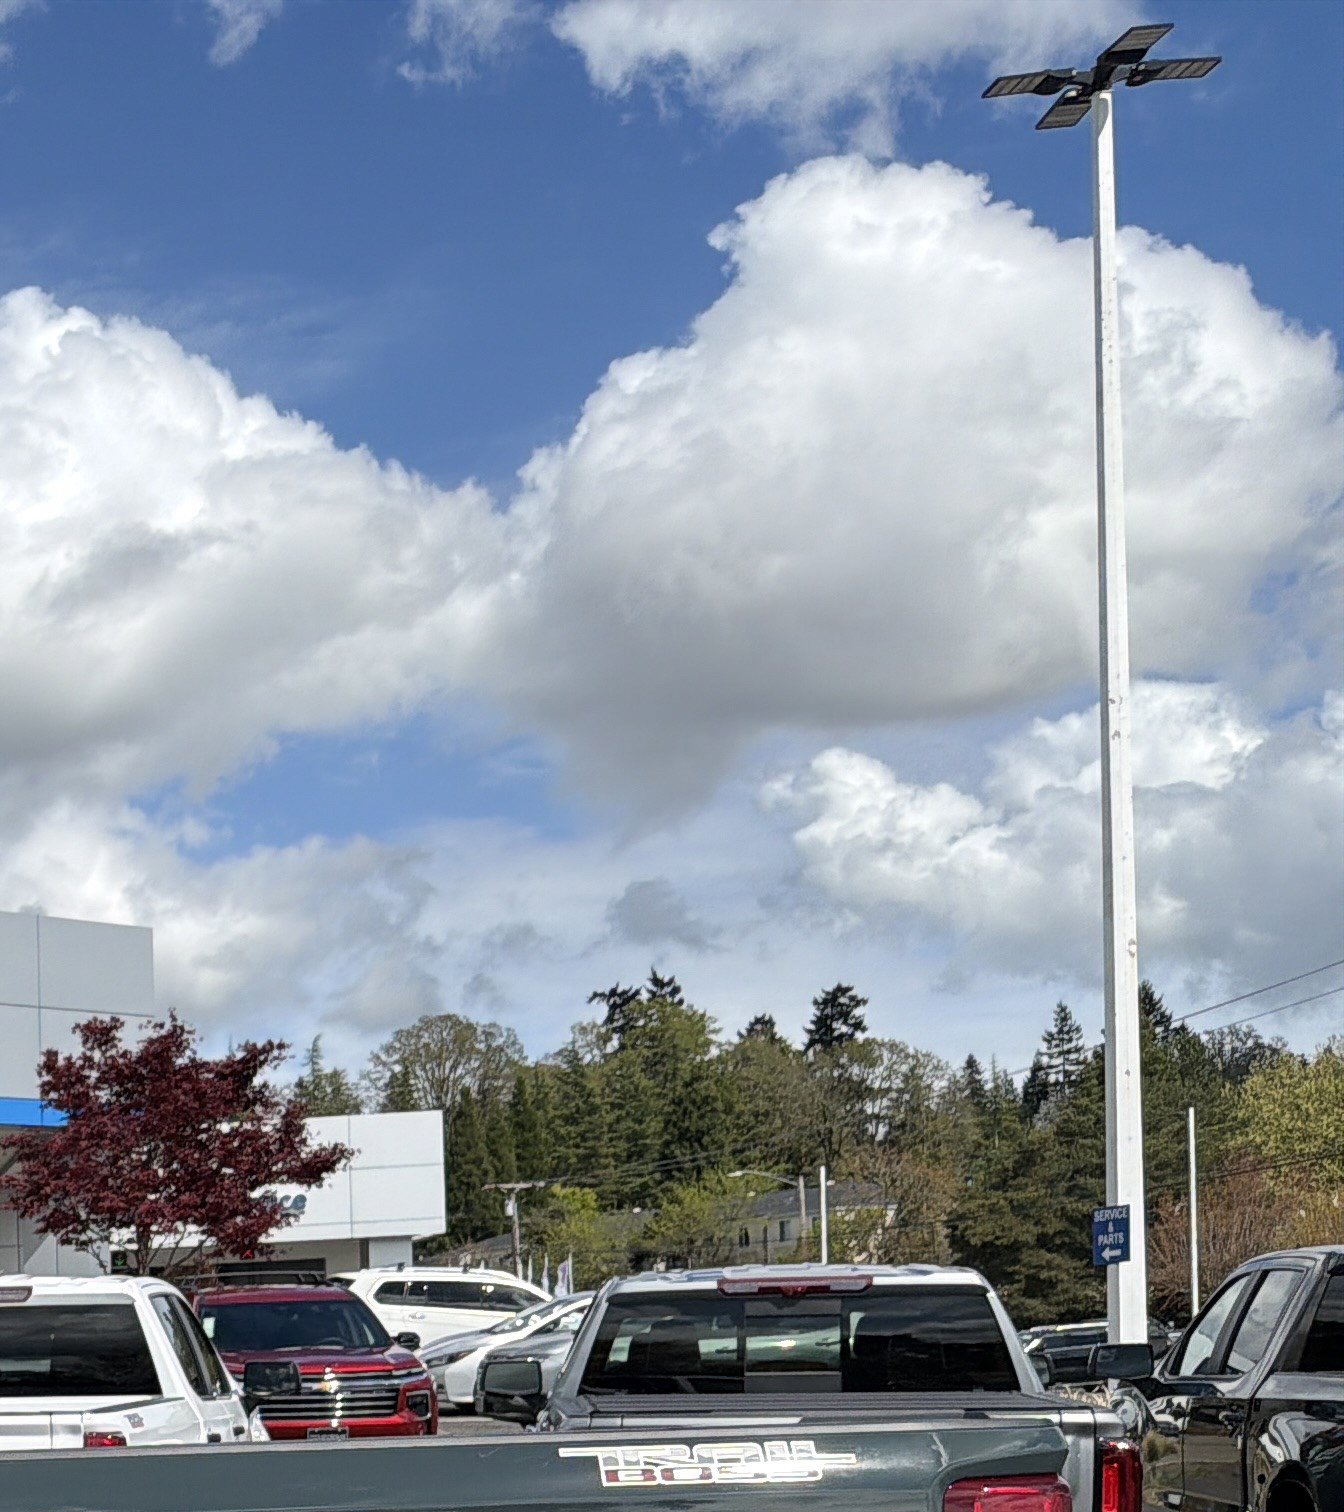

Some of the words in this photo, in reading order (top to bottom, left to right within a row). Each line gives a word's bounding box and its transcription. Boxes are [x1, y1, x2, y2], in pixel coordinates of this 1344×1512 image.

[1093, 1207, 1128, 1222] SERVICE
[1108, 1221, 1114, 1233] &
[1097, 1232, 1125, 1247] PARTS
[558, 1440, 857, 1468] TRAIL
